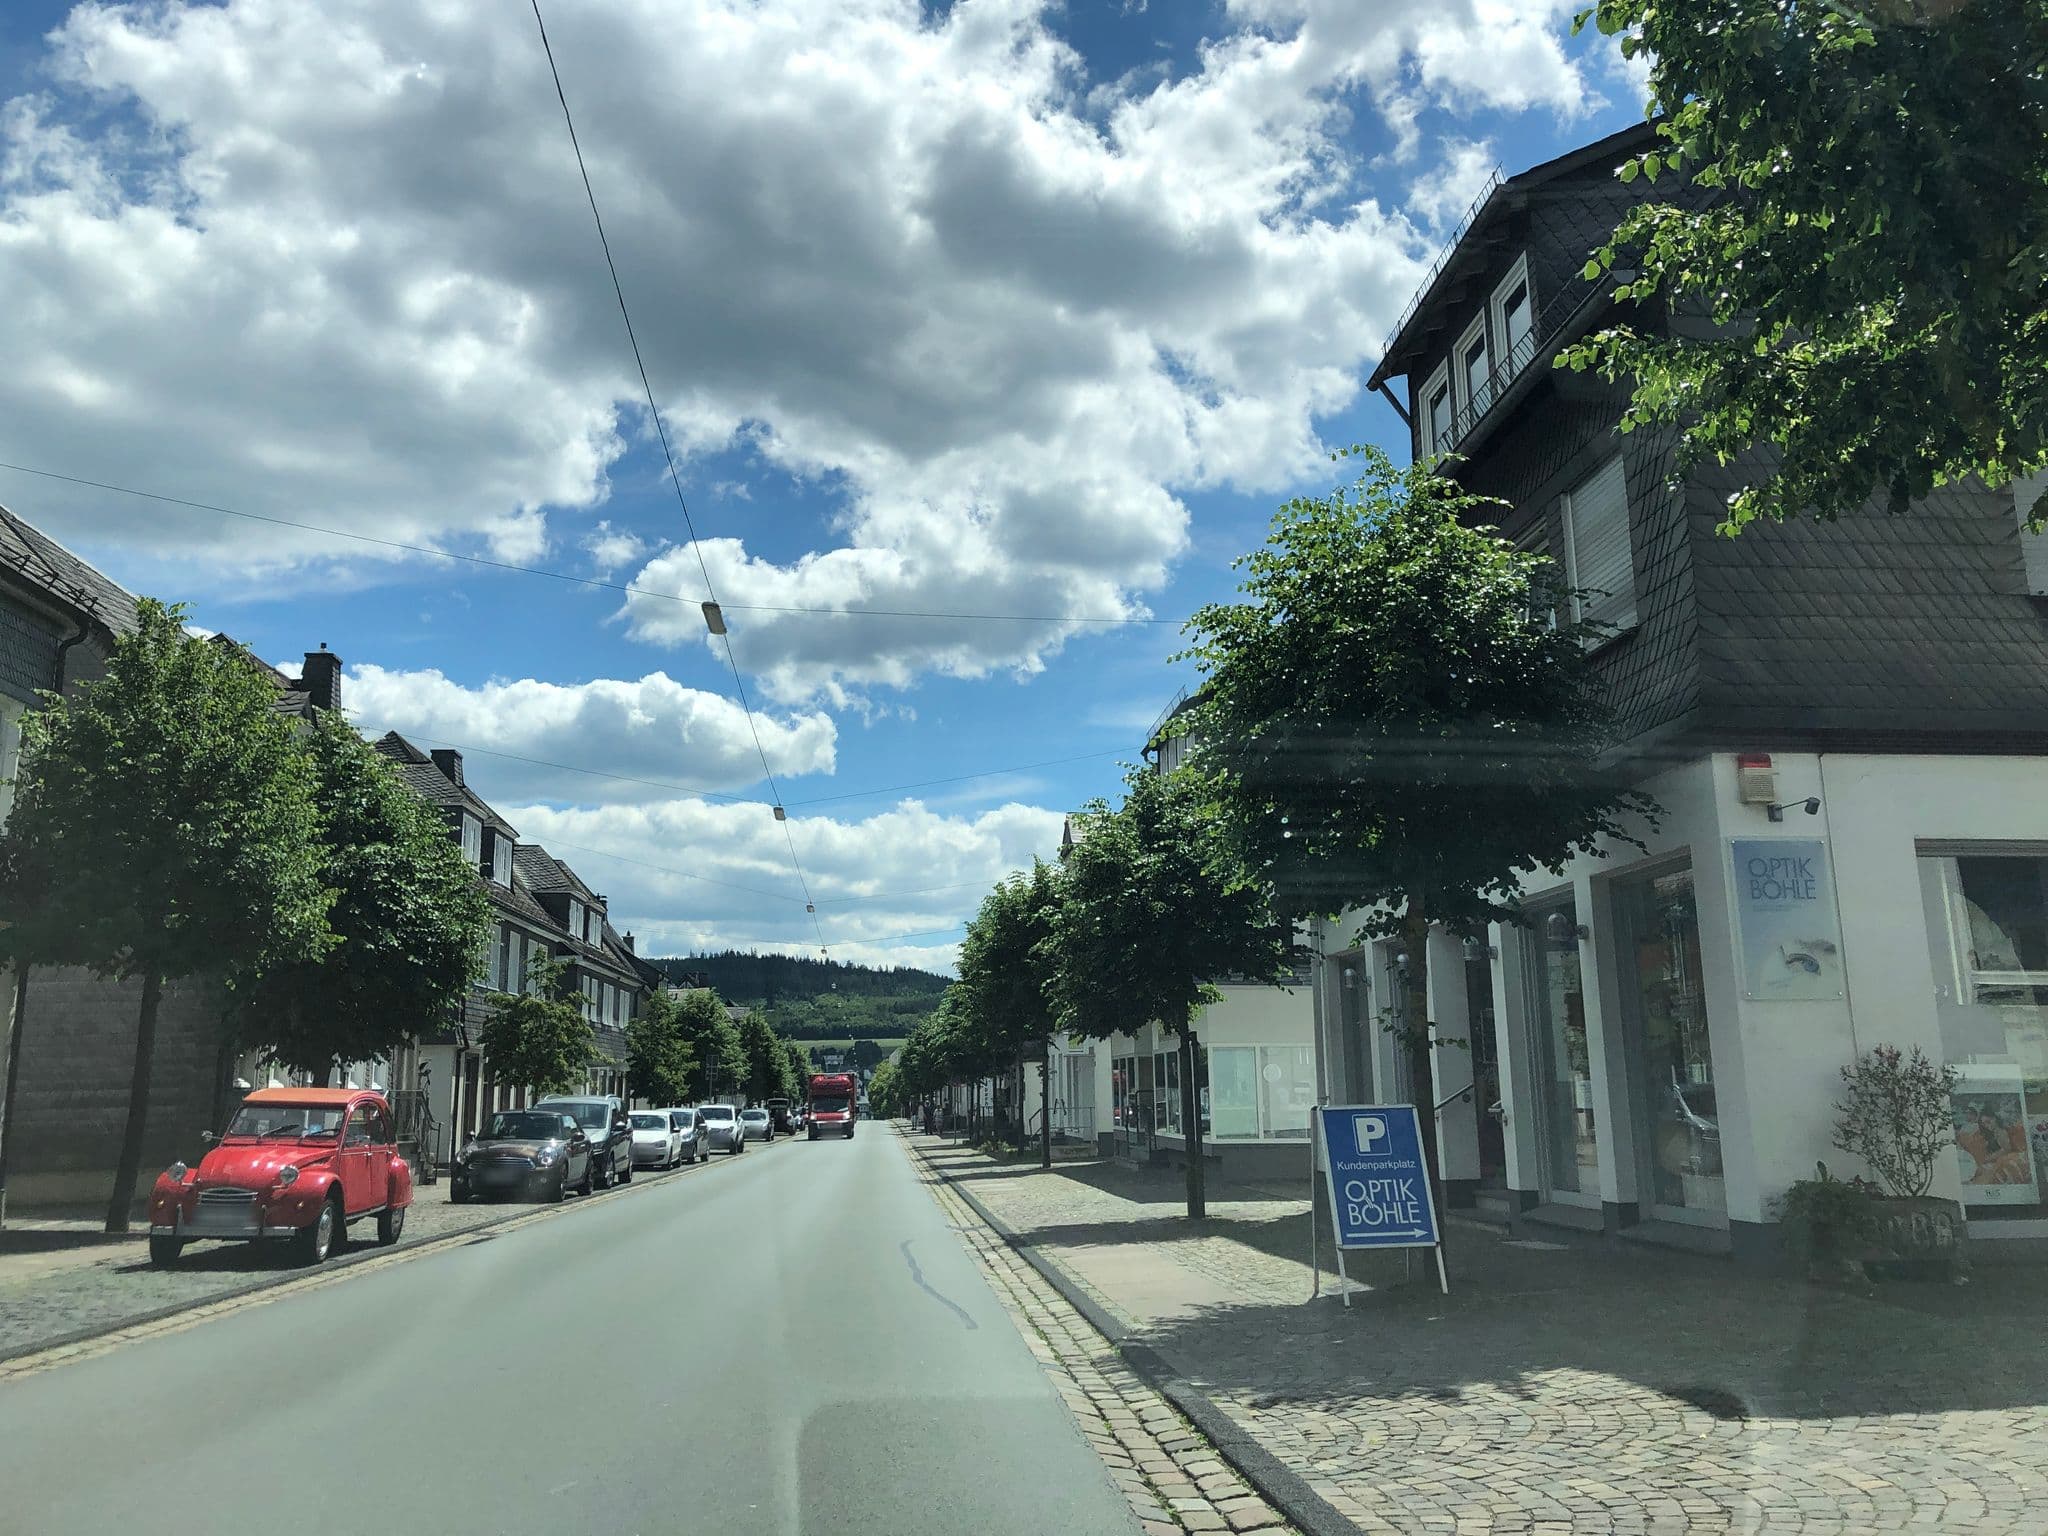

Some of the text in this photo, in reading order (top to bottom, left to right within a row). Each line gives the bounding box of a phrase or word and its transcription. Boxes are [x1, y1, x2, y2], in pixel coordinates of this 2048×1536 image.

[1748, 857, 1814, 878] OPTIK
[1355, 1117, 1386, 1152] P
[1337, 1160, 1416, 1170] Kundenparkplatz
[1345, 1178, 1417, 1203] OPTIK
